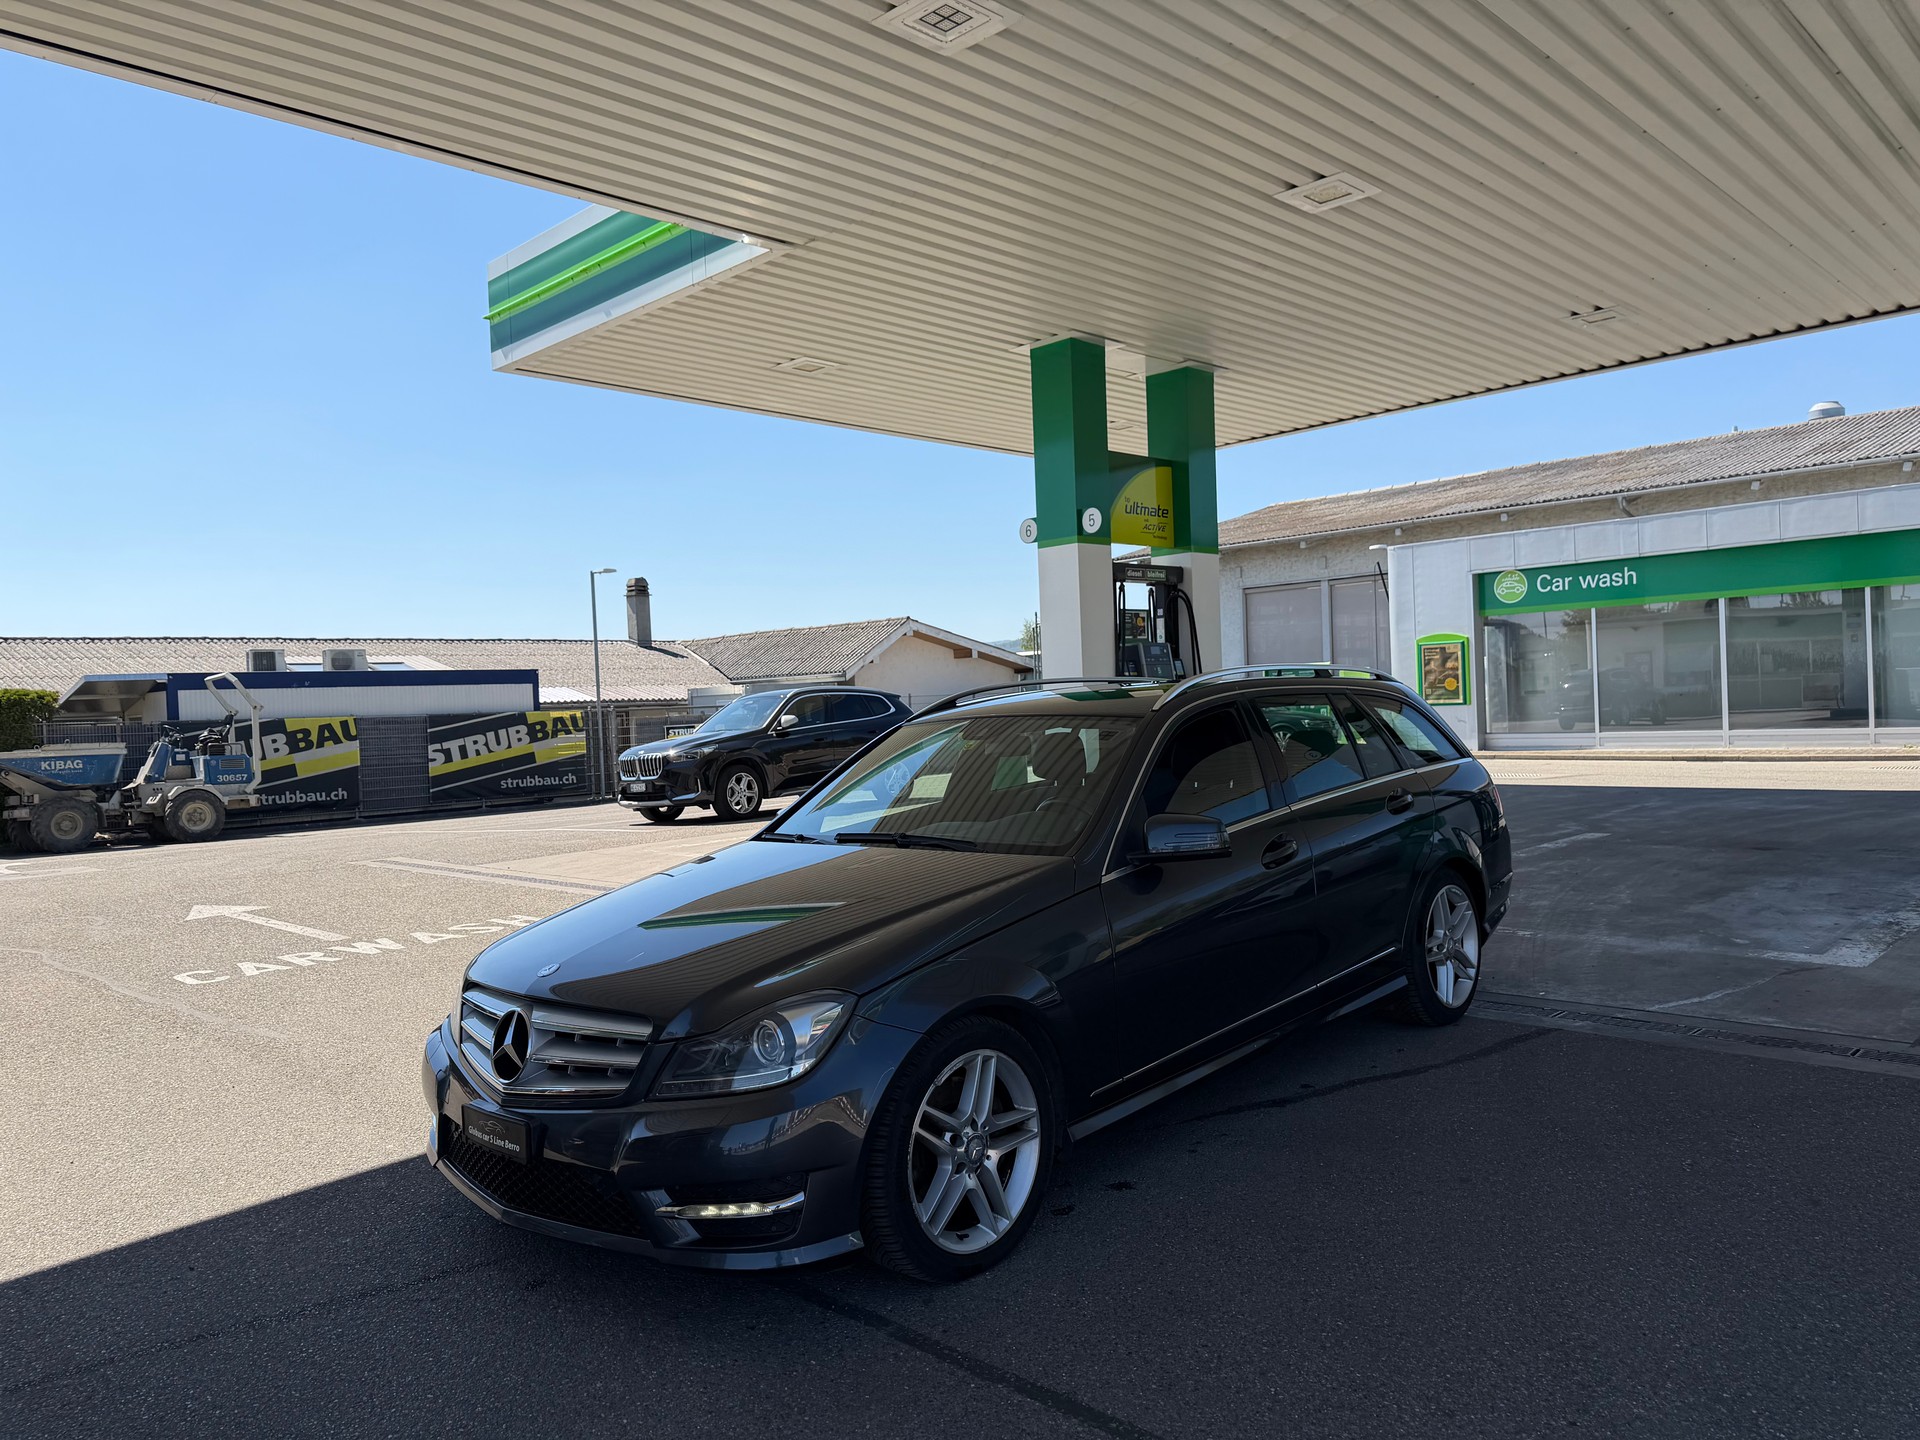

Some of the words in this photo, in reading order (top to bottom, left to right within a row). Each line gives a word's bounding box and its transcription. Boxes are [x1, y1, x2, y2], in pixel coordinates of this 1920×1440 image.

[1124, 501, 1169, 519] ultimate
[1088, 514, 1095, 527] 5
[1025, 525, 1031, 537] 6
[1142, 523, 1167, 533] ACTIVE
[1536, 573, 1573, 593] Car
[1579, 566, 1637, 589] wash
[40, 759, 83, 771] KIBAG
[216, 773, 248, 782] 30657
[500, 773, 577, 789] strubbau.ch
[261, 787, 348, 805] trubbau.ch
[494, 1136, 504, 1147] Line
